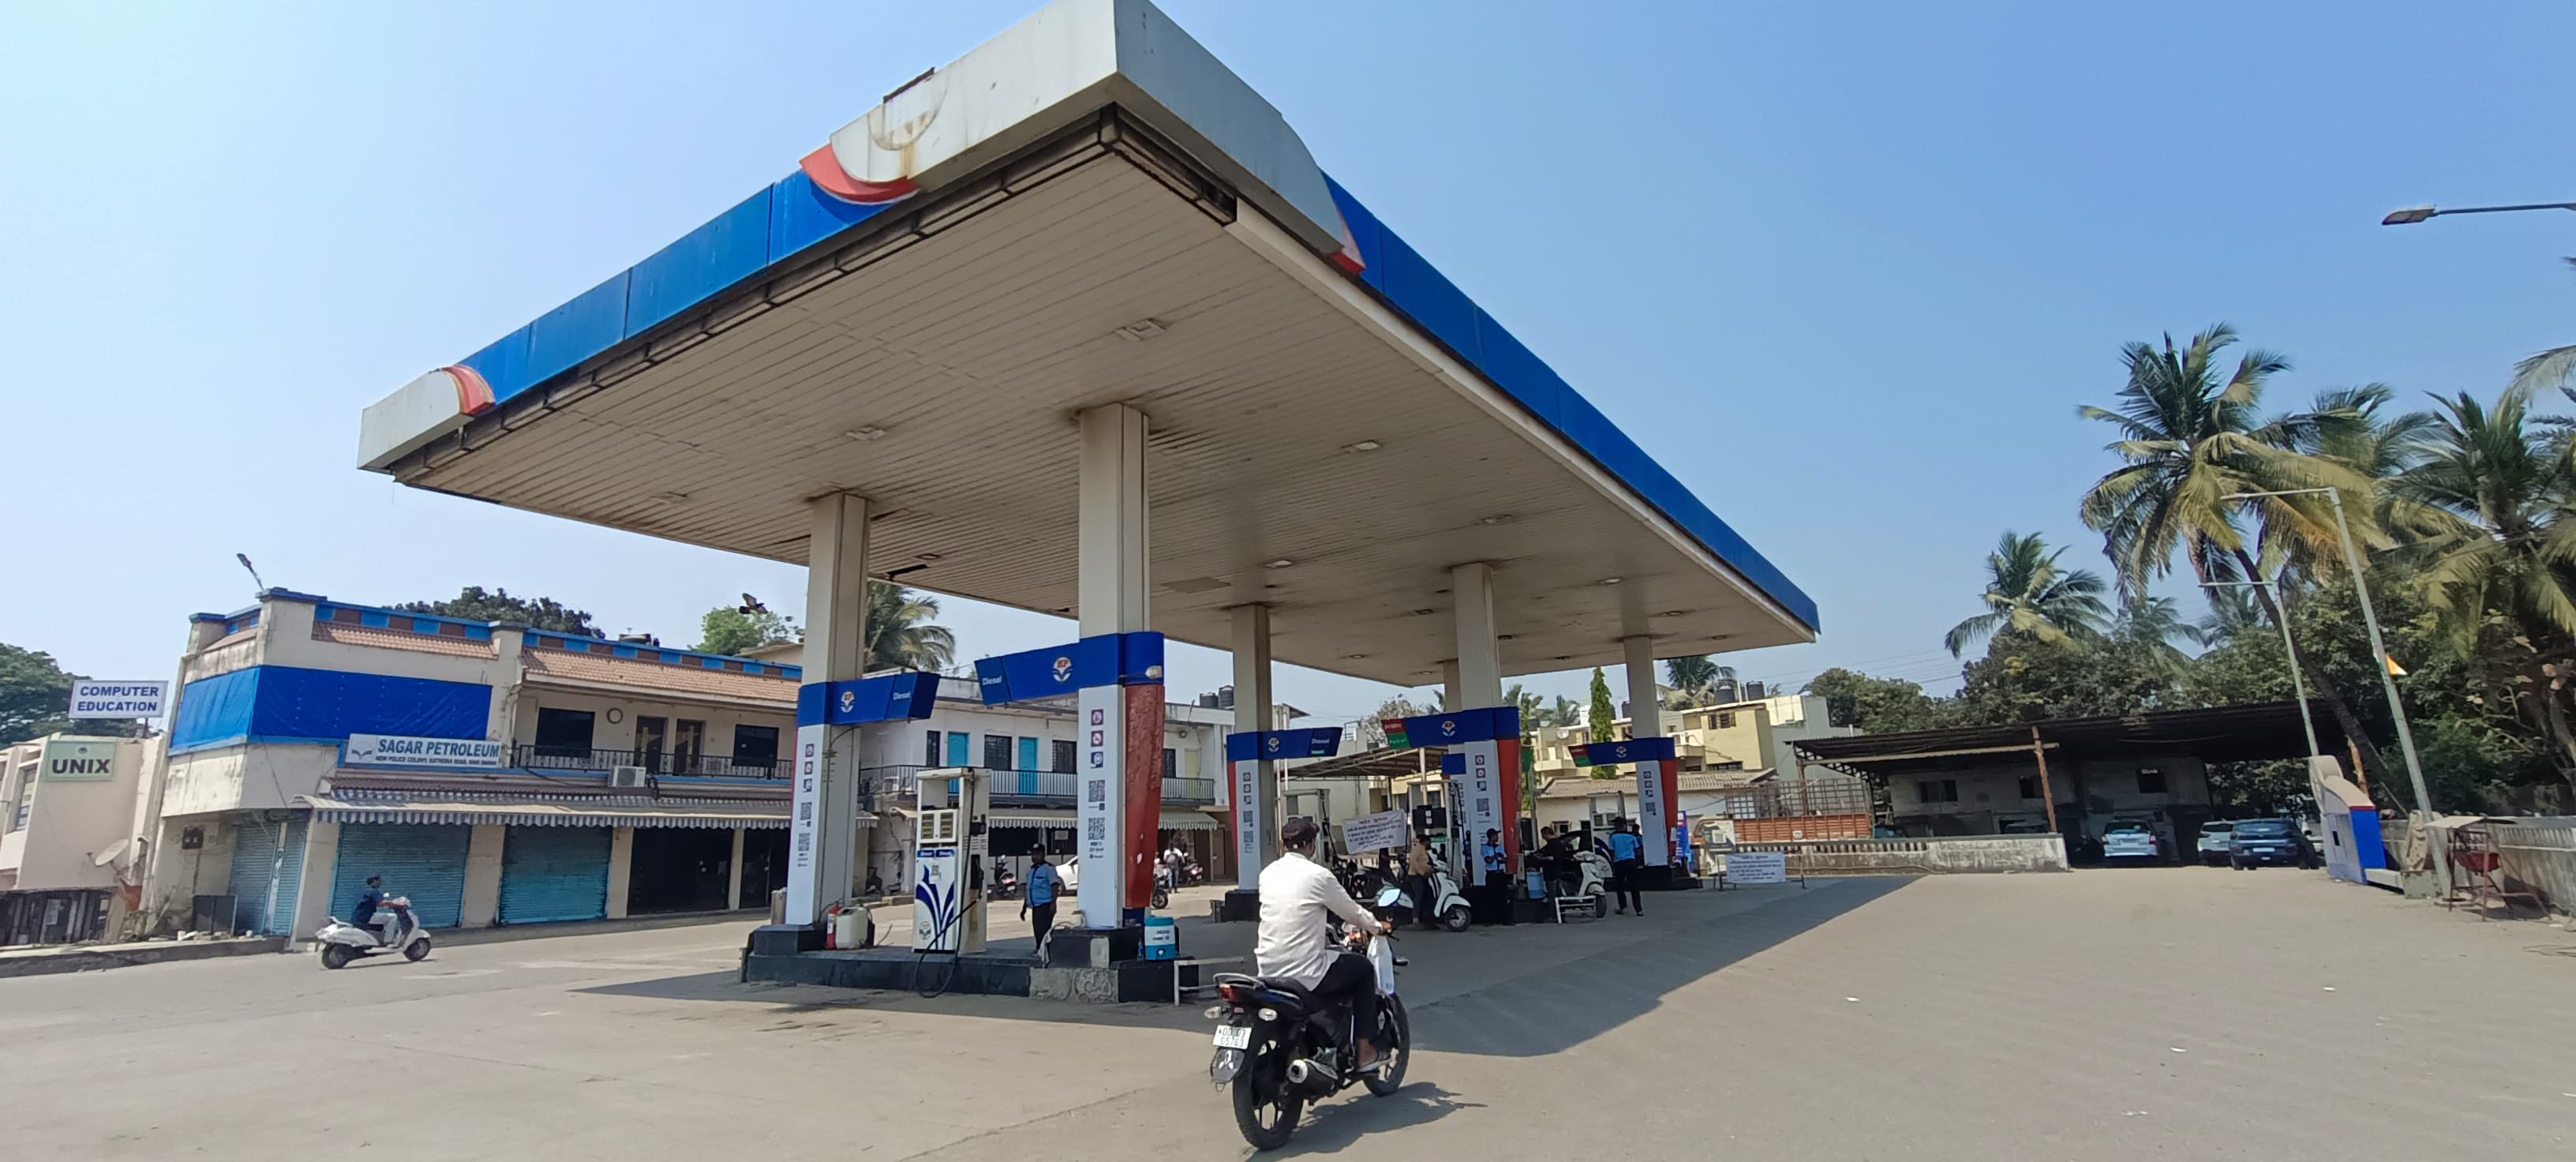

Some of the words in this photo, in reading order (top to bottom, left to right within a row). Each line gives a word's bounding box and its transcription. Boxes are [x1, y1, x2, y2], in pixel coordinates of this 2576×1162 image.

[80, 686, 159, 697] COMPUTER
[77, 701, 158, 712] EDUCATION
[377, 739, 424, 754] SAGAR
[425, 741, 500, 758] PETROLEUM
[52, 759, 110, 774] UNIX
